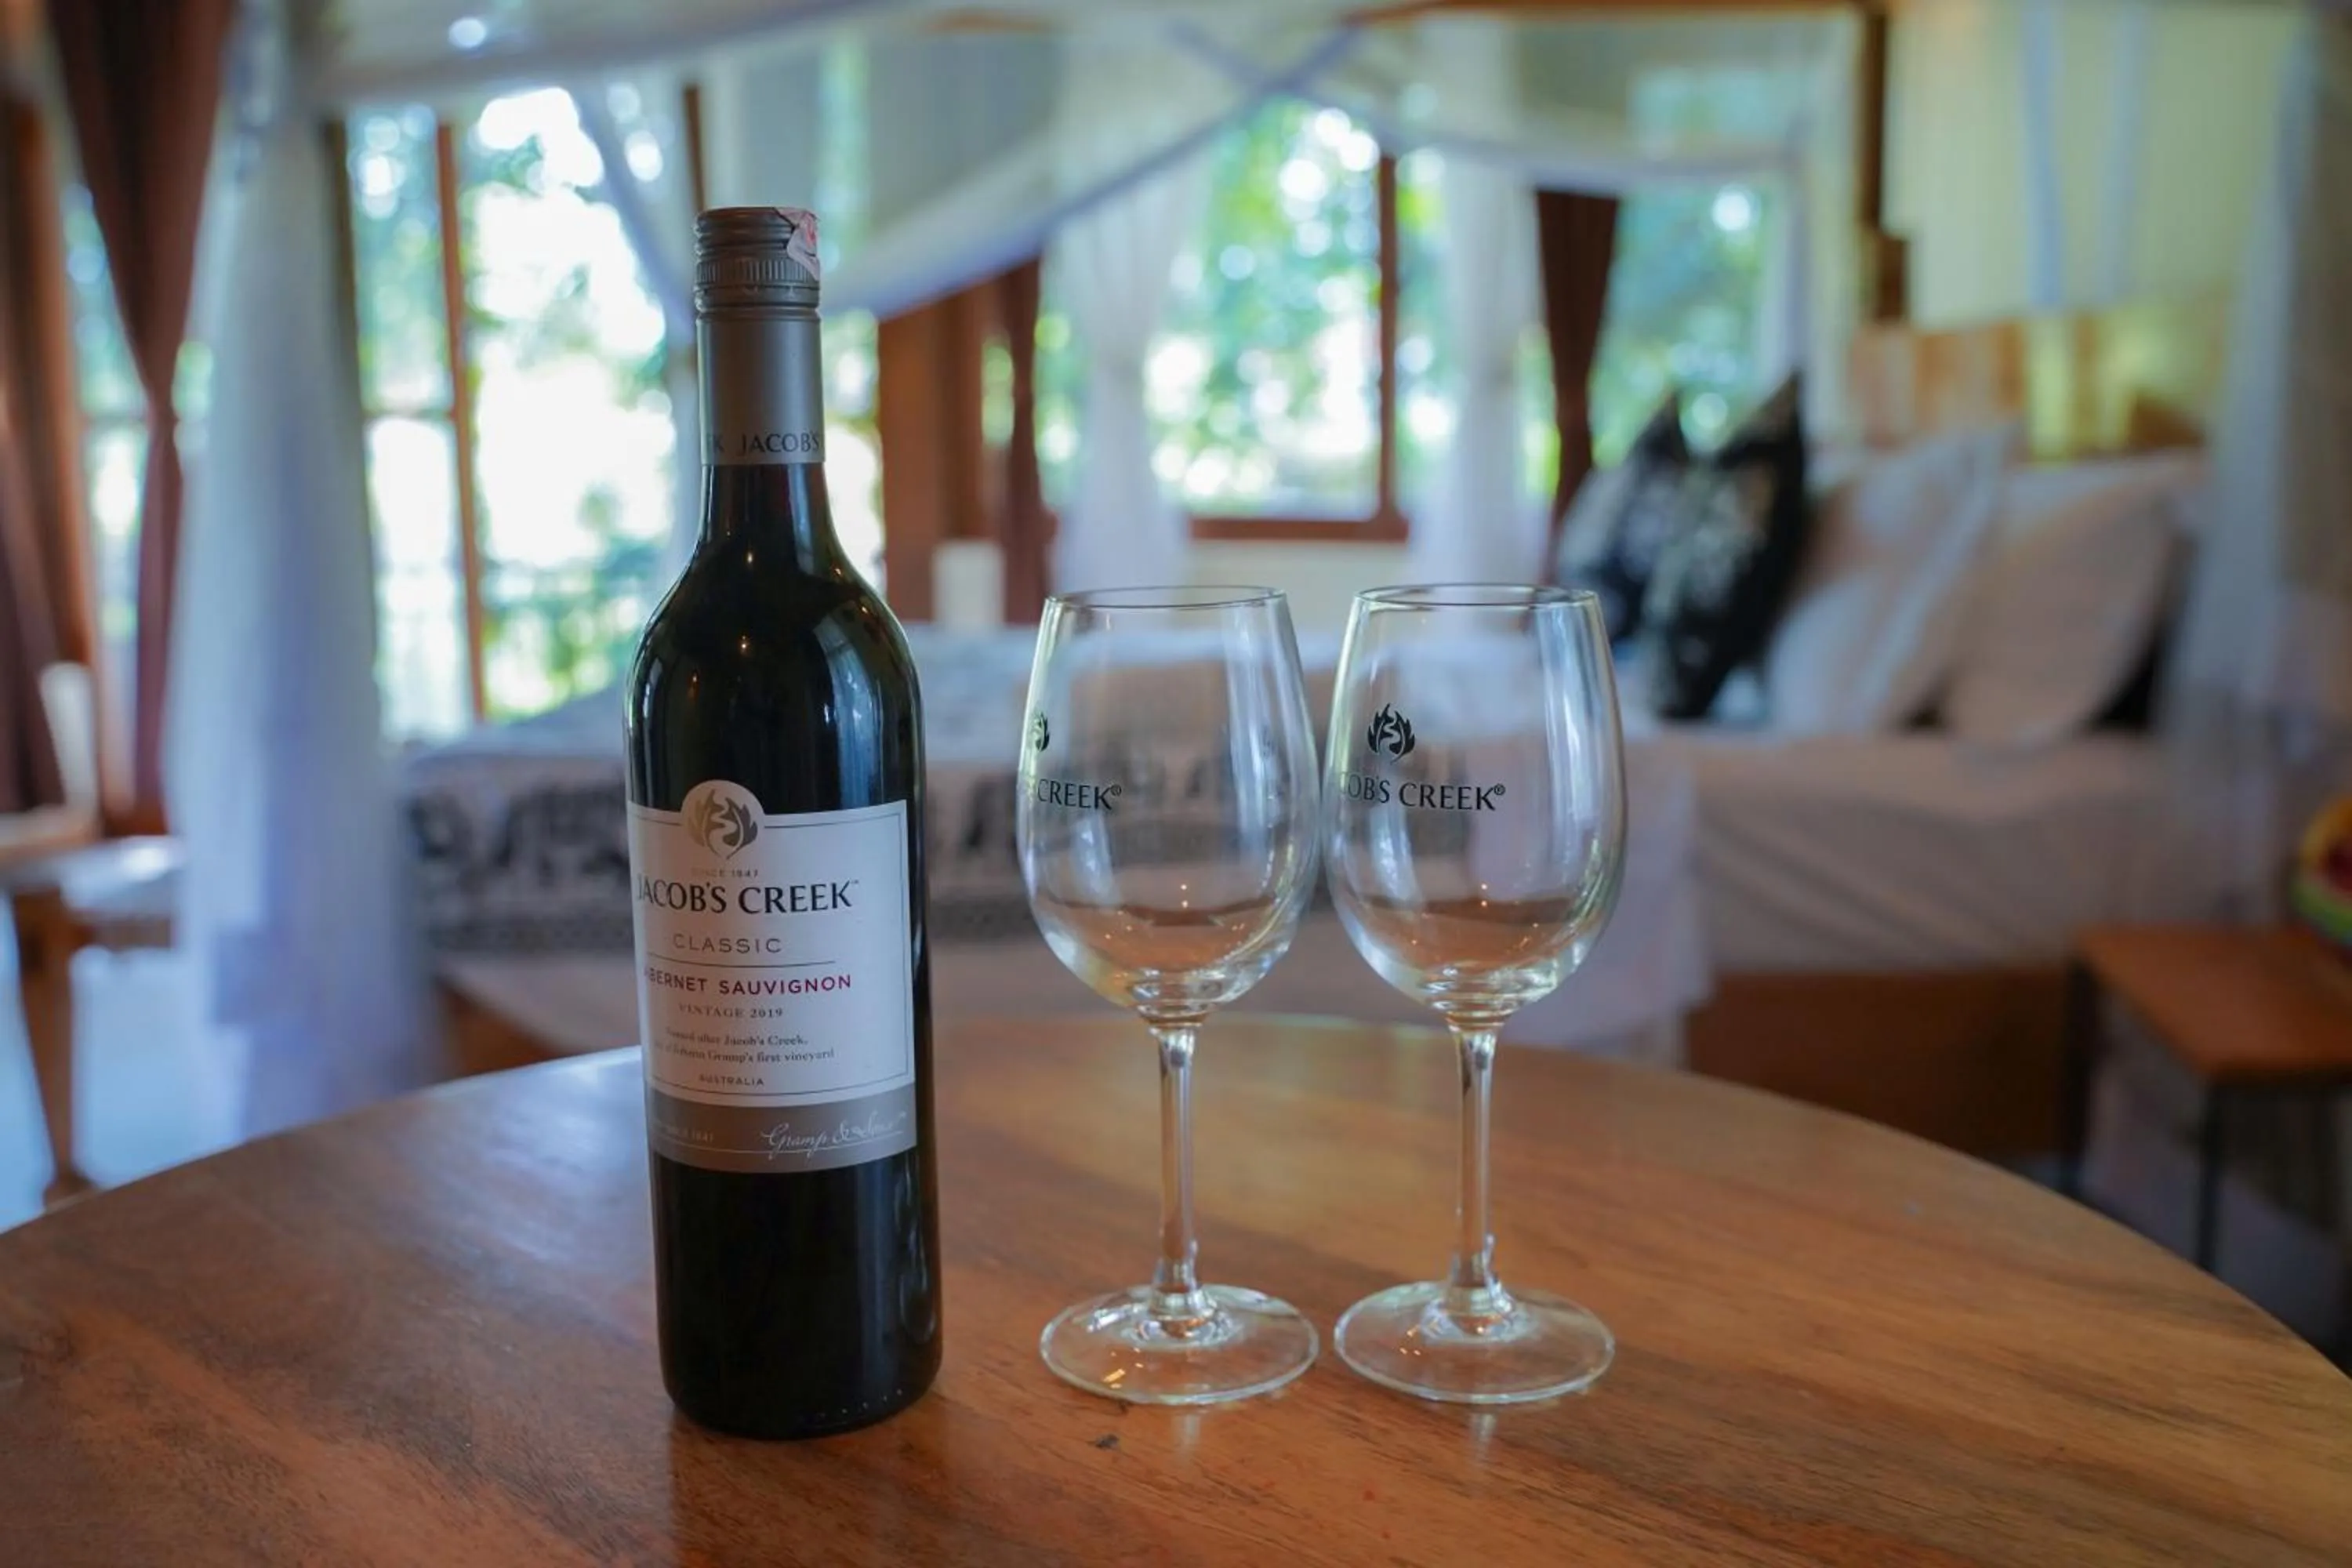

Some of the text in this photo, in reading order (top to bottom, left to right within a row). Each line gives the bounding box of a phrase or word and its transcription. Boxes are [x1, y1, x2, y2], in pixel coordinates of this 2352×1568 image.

[637, 873, 727, 914] JACOB'S
[673, 933, 782, 954] CLASSIC
[719, 974, 851, 995] SAUVIGNON
[678, 1003, 783, 1018] VINTAGE 2019
[783, 1047, 835, 1062] vineyard
[699, 1073, 764, 1086] AUSTRALIA
